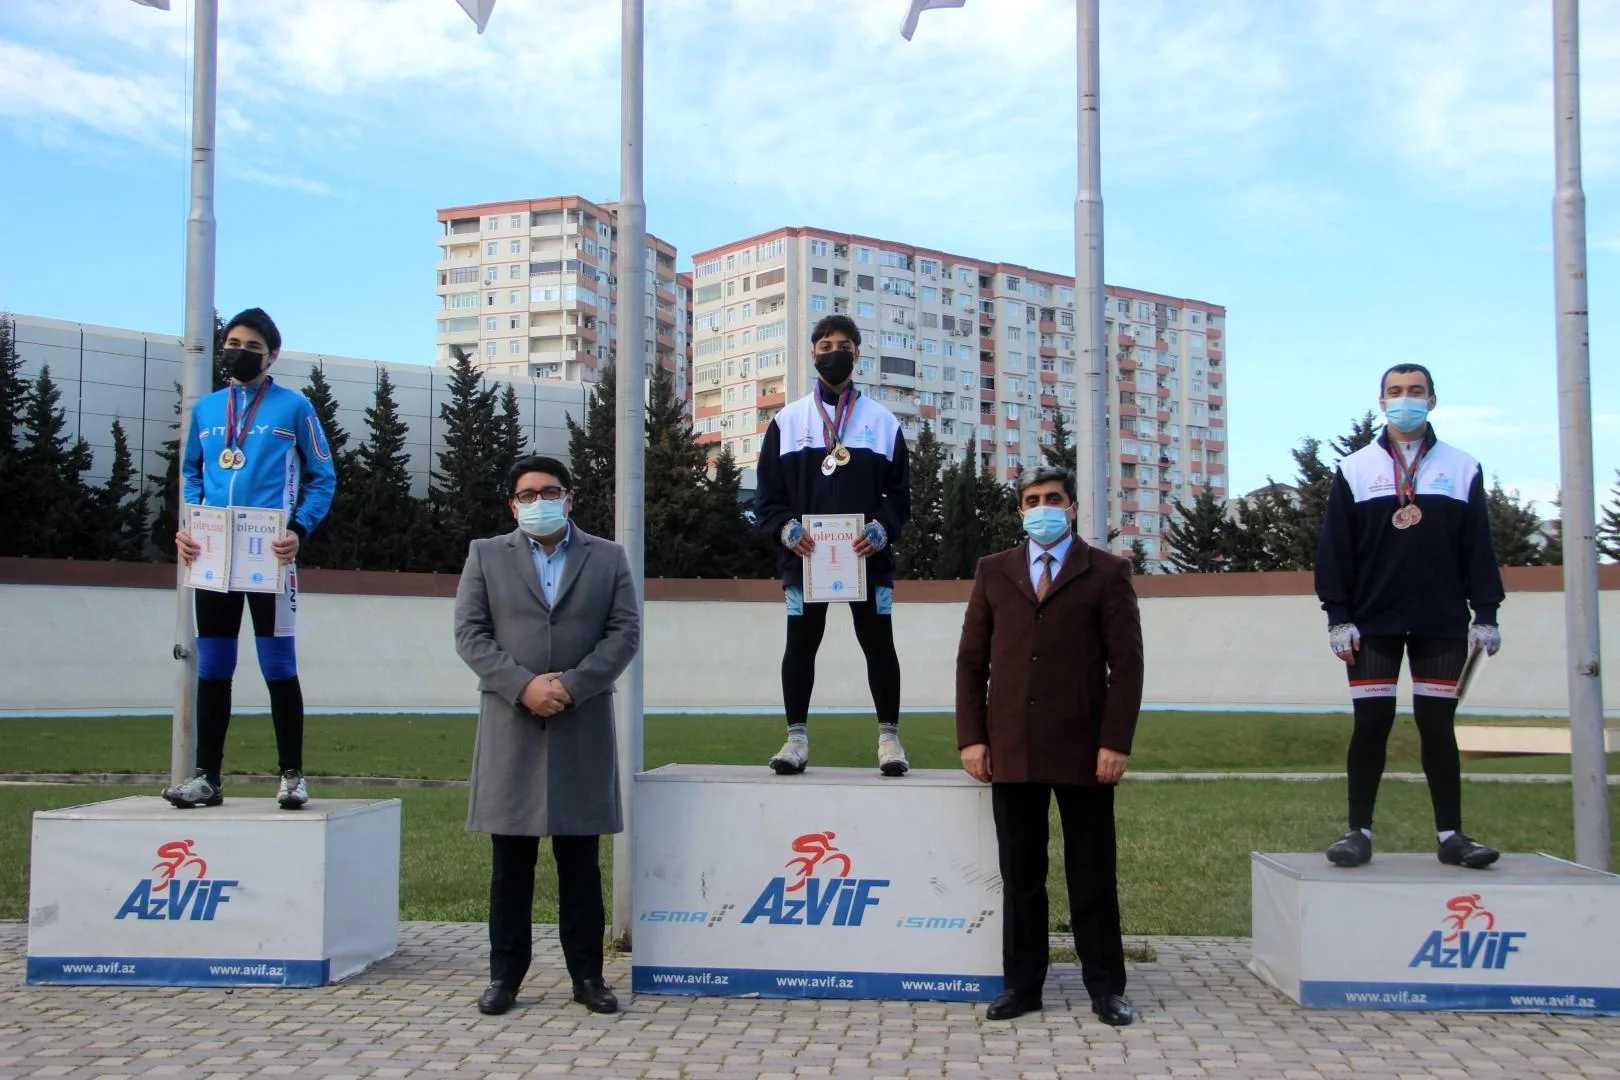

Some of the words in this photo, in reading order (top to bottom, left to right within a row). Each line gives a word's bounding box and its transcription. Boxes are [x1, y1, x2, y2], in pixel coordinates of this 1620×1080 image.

[212, 424, 270, 436] ITY
[248, 536, 265, 555] II
[829, 545, 839, 564] I
[62, 962, 136, 975] www.avif.az
[210, 964, 284, 977] www.avif.az
[653, 973, 729, 986] www.avif.az
[776, 976, 854, 989] www.avif.az
[901, 979, 981, 993] www.avif.az
[1346, 991, 1428, 1004] www.avif.az
[1511, 994, 1596, 1009] www.avif.az
